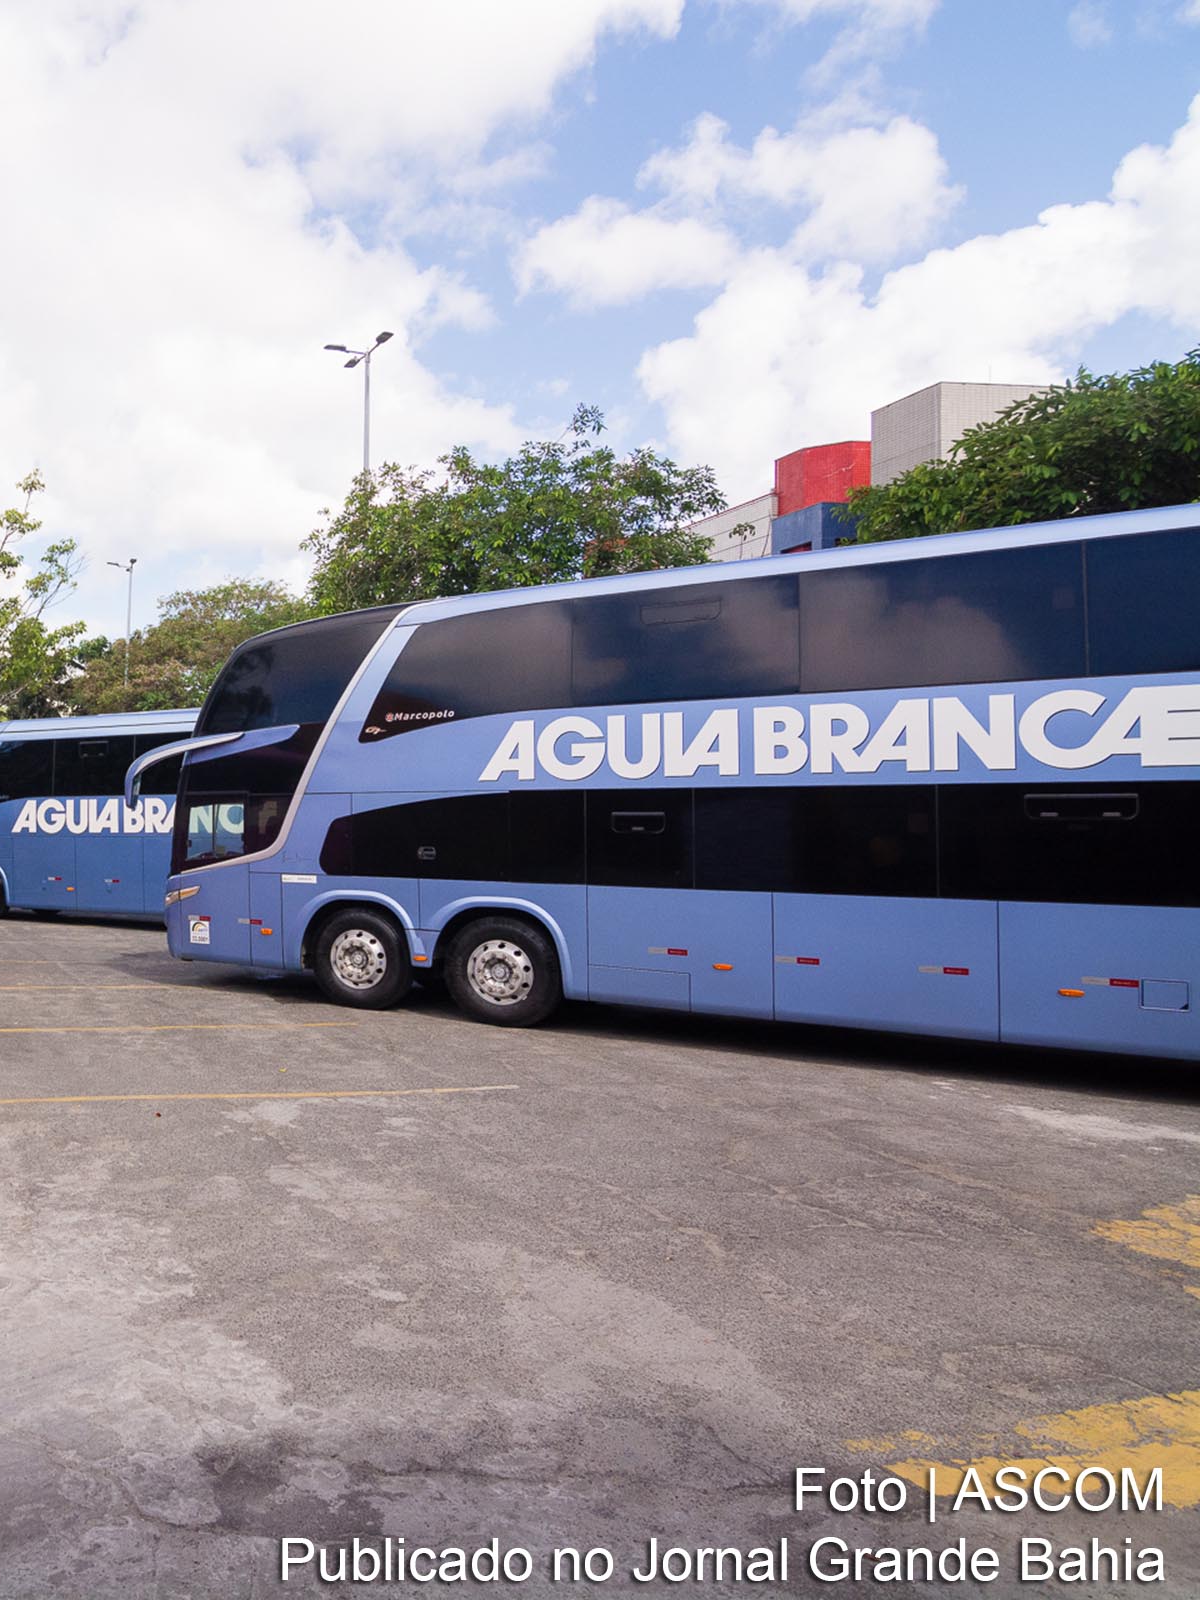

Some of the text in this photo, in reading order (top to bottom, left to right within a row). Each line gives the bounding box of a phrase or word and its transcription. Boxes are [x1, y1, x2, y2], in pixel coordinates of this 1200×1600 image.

[478, 687, 1142, 782] AGUIA BRANCA
[12, 798, 117, 834] AGUIA
